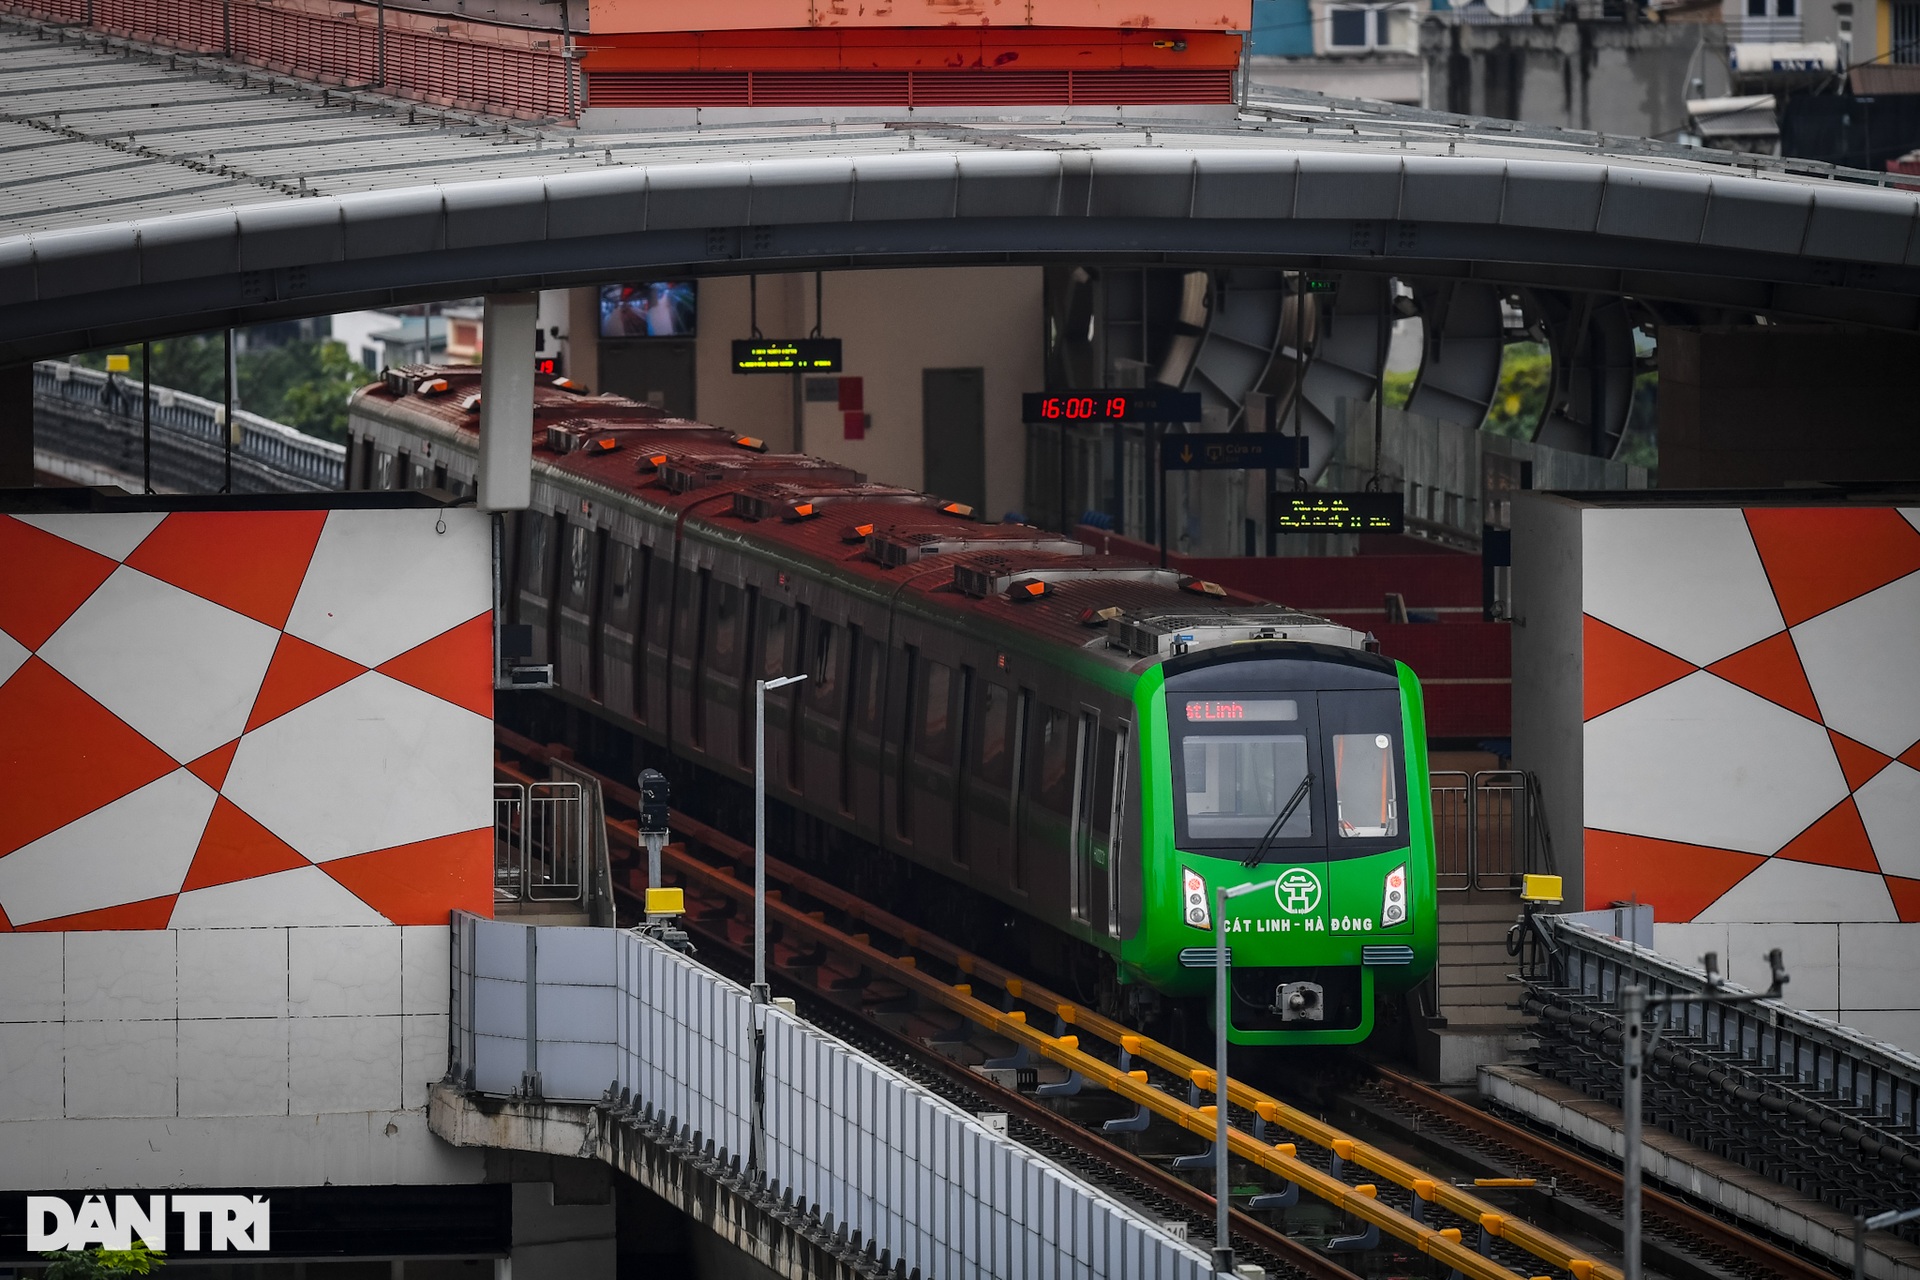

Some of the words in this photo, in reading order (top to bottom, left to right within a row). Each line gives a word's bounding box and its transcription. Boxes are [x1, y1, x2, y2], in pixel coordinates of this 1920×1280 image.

[1041, 397, 1126, 419] 16:00:19
[1205, 702, 1243, 719] Linh
[1223, 917, 1252, 932] CÁT
[1256, 919, 1291, 932] LINH
[1304, 916, 1325, 931] HÀ
[1331, 915, 1373, 931] ĐÔNG
